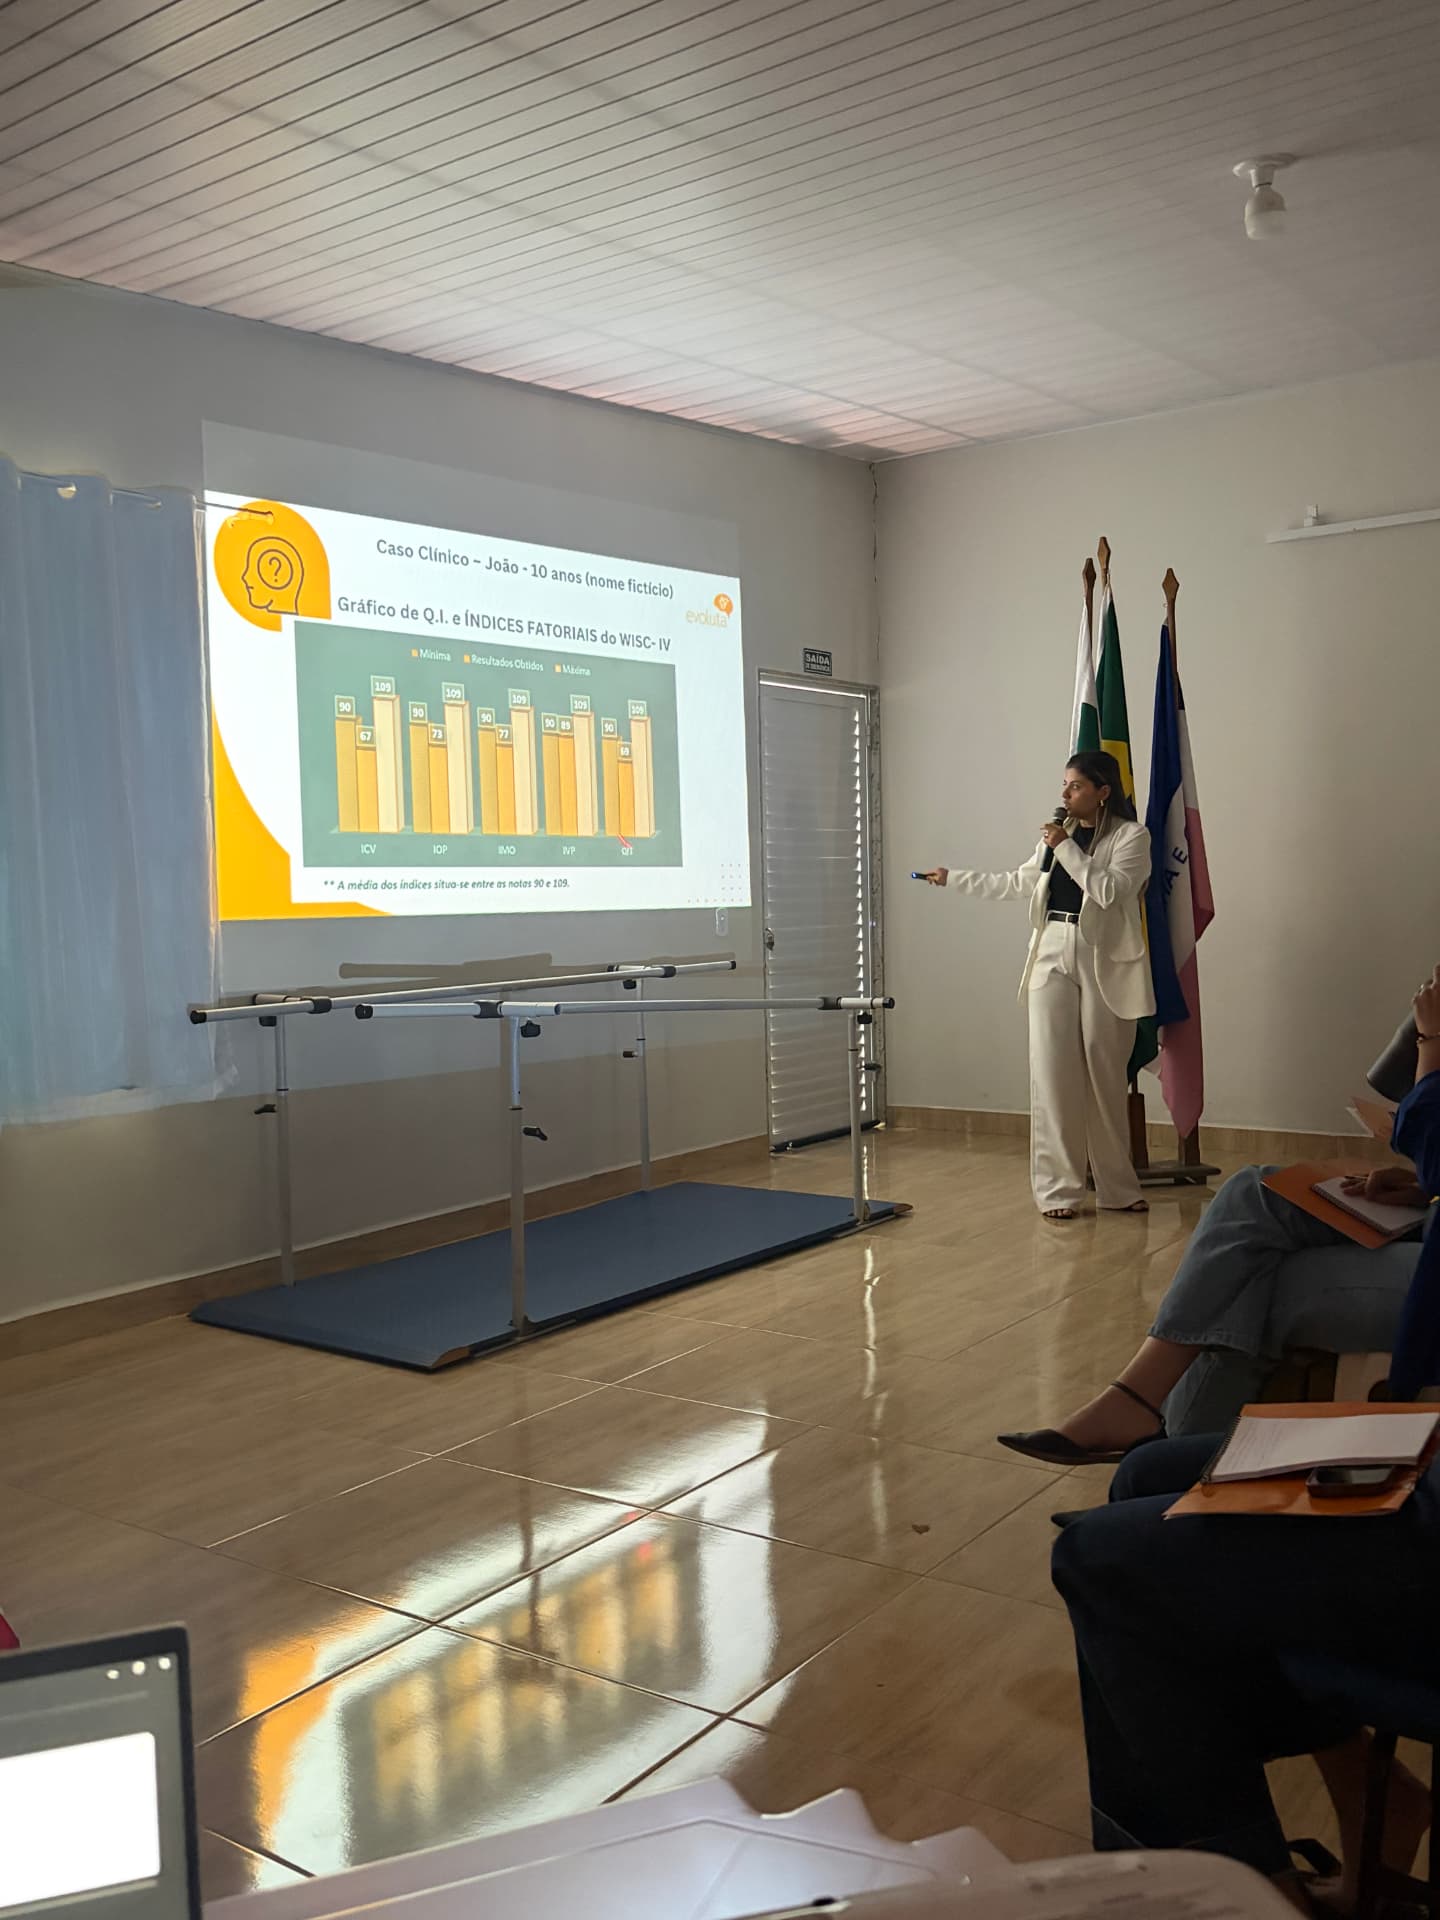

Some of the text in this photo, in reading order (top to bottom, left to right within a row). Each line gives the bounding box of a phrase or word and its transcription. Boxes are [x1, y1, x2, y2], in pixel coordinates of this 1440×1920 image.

[376, 539, 414, 558] Caso
[418, 545, 469, 566] Clínico
[485, 556, 519, 574] João
[531, 563, 548, 578] 10
[551, 569, 582, 584] anos
[585, 571, 625, 591] (nome
[628, 578, 674, 600] fictício)
[685, 608, 728, 628] evoluta
[337, 597, 396, 617] Gráfico
[400, 604, 419, 620] de
[423, 607, 448, 624] Q.I.
[452, 614, 461, 625] e
[464, 609, 524, 634] ÍNDICES
[527, 620, 598, 643] FATORIAIS
[600, 630, 617, 645] do
[659, 638, 672, 652] IV
[471, 654, 544, 672] Resultados Obtidos
[375, 682, 391, 693] 109
[446, 688, 462, 699] 109
[512, 694, 527, 704] 109
[339, 702, 351, 712] 90
[574, 700, 588, 710] 109
[631, 705, 645, 714] 109
[412, 707, 424, 717] 90
[481, 713, 492, 723] 90
[545, 718, 555, 728] 90
[561, 721, 571, 730] 89
[604, 723, 614, 733] 90
[359, 731, 372, 741] 67
[432, 728, 443, 739] 73
[498, 729, 509, 739] 77
[361, 843, 377, 854] ICV
[433, 844, 448, 854] IOP
[498, 845, 516, 855] IMO
[562, 846, 576, 856] IVP
[337, 880, 345, 890] A
[347, 879, 378, 890] média
[380, 880, 398, 890] dos
[400, 879, 432, 890] índices
[434, 879, 470, 889] situa-se
[471, 879, 494, 889] entre
[497, 881, 506, 889] as
[508, 879, 532, 889] notas
[534, 879, 544, 888] 90
[553, 879, 570, 888] 109.
